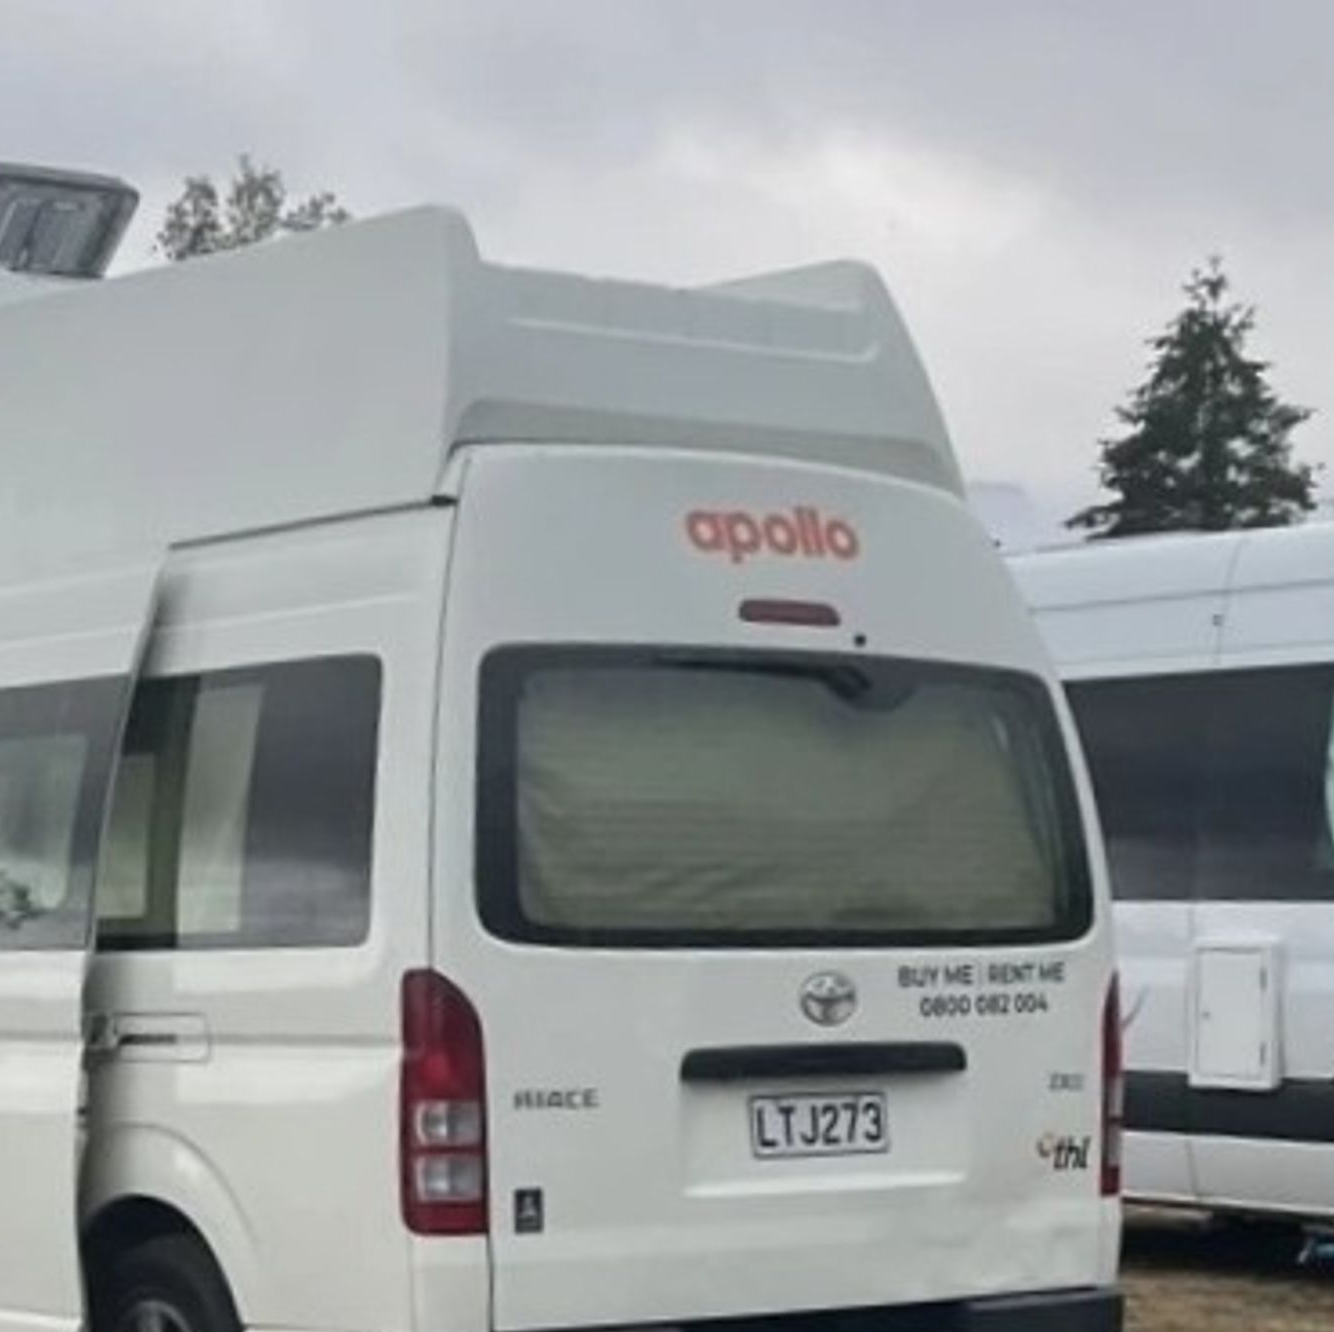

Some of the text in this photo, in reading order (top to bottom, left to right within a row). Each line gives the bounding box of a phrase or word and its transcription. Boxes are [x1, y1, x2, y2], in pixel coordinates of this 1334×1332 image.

[687, 506, 859, 564] apollo
[898, 961, 1065, 988] BUY ME RENT ME
[920, 995, 971, 1017] 0800
[1014, 993, 1048, 1013] 004
[756, 1102, 883, 1148] LTJ273
